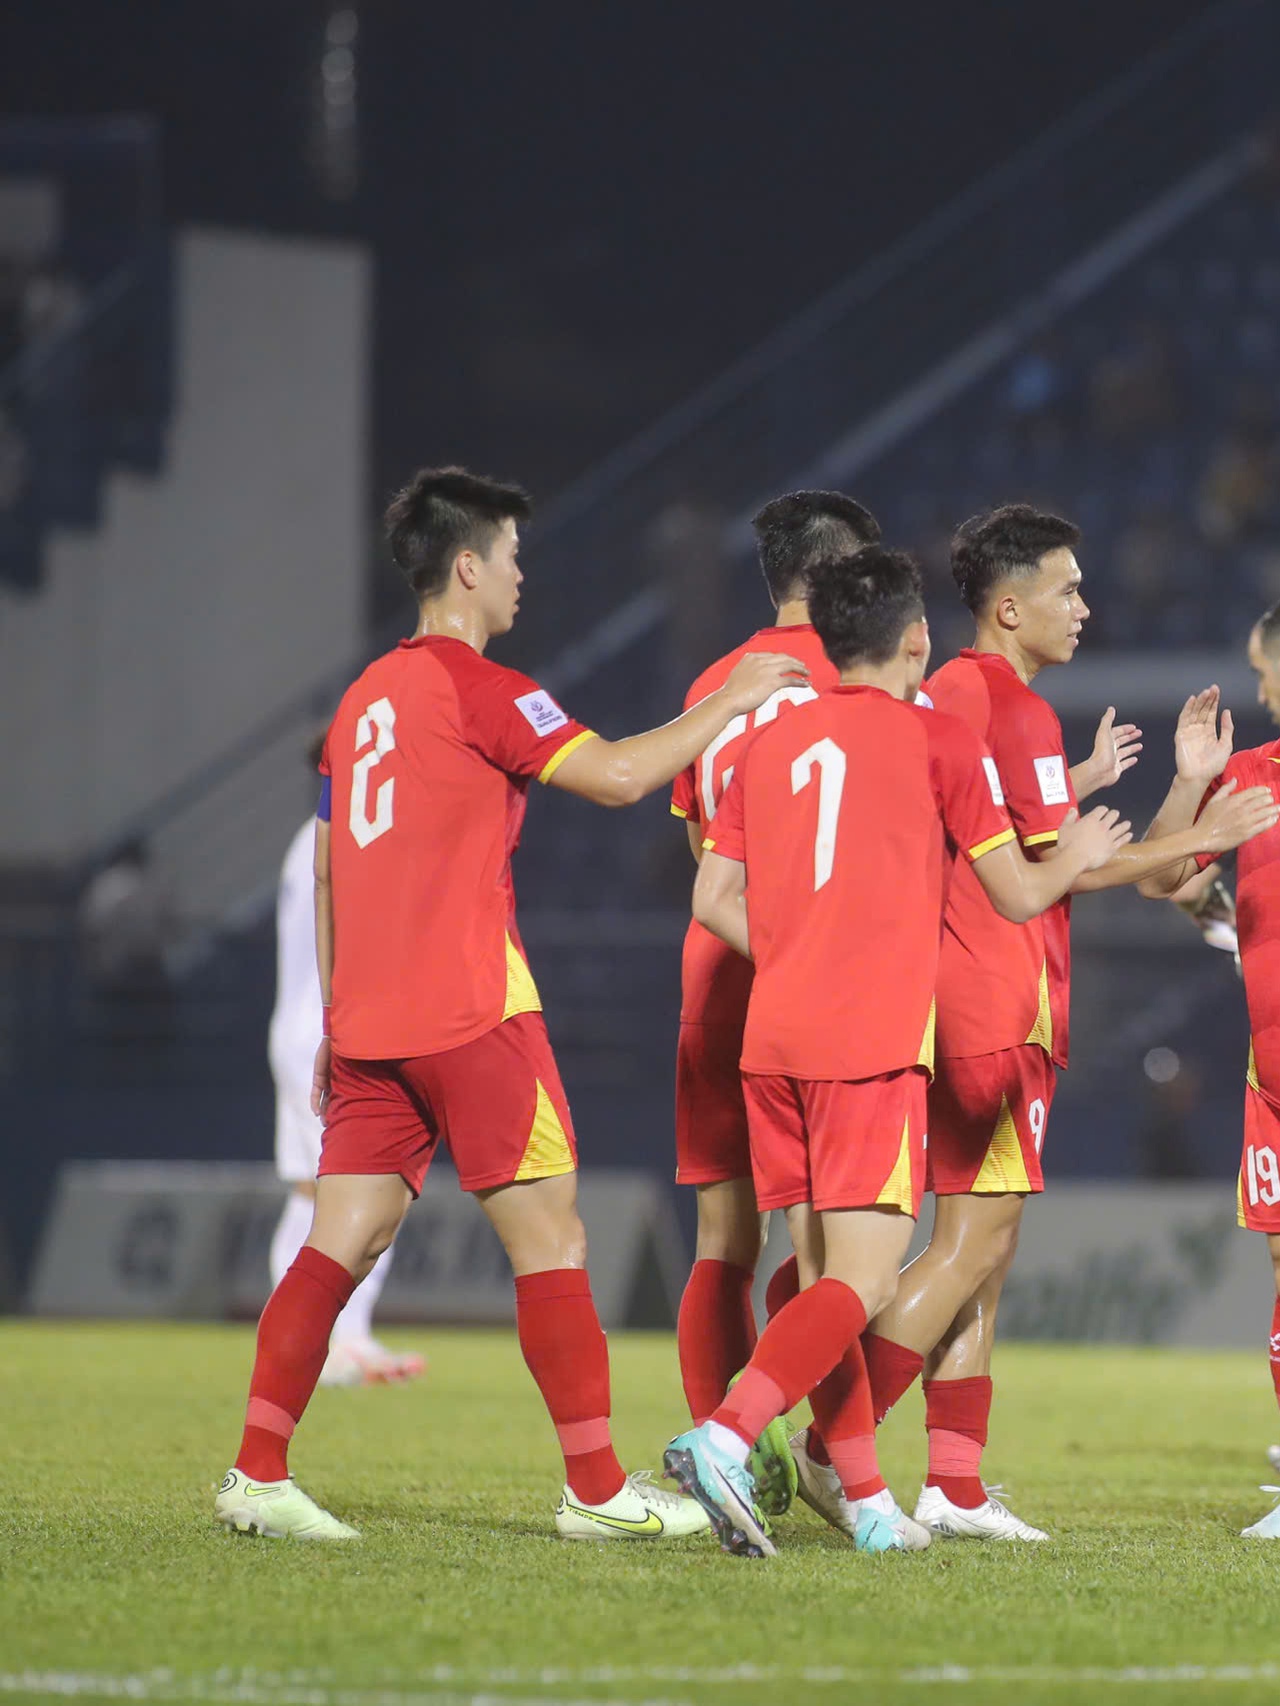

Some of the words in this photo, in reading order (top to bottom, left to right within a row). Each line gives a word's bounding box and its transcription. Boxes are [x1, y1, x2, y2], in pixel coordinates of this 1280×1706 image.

[350, 697, 396, 849] 2
[791, 737, 846, 892] 7
[1028, 1098, 1046, 1155] 9
